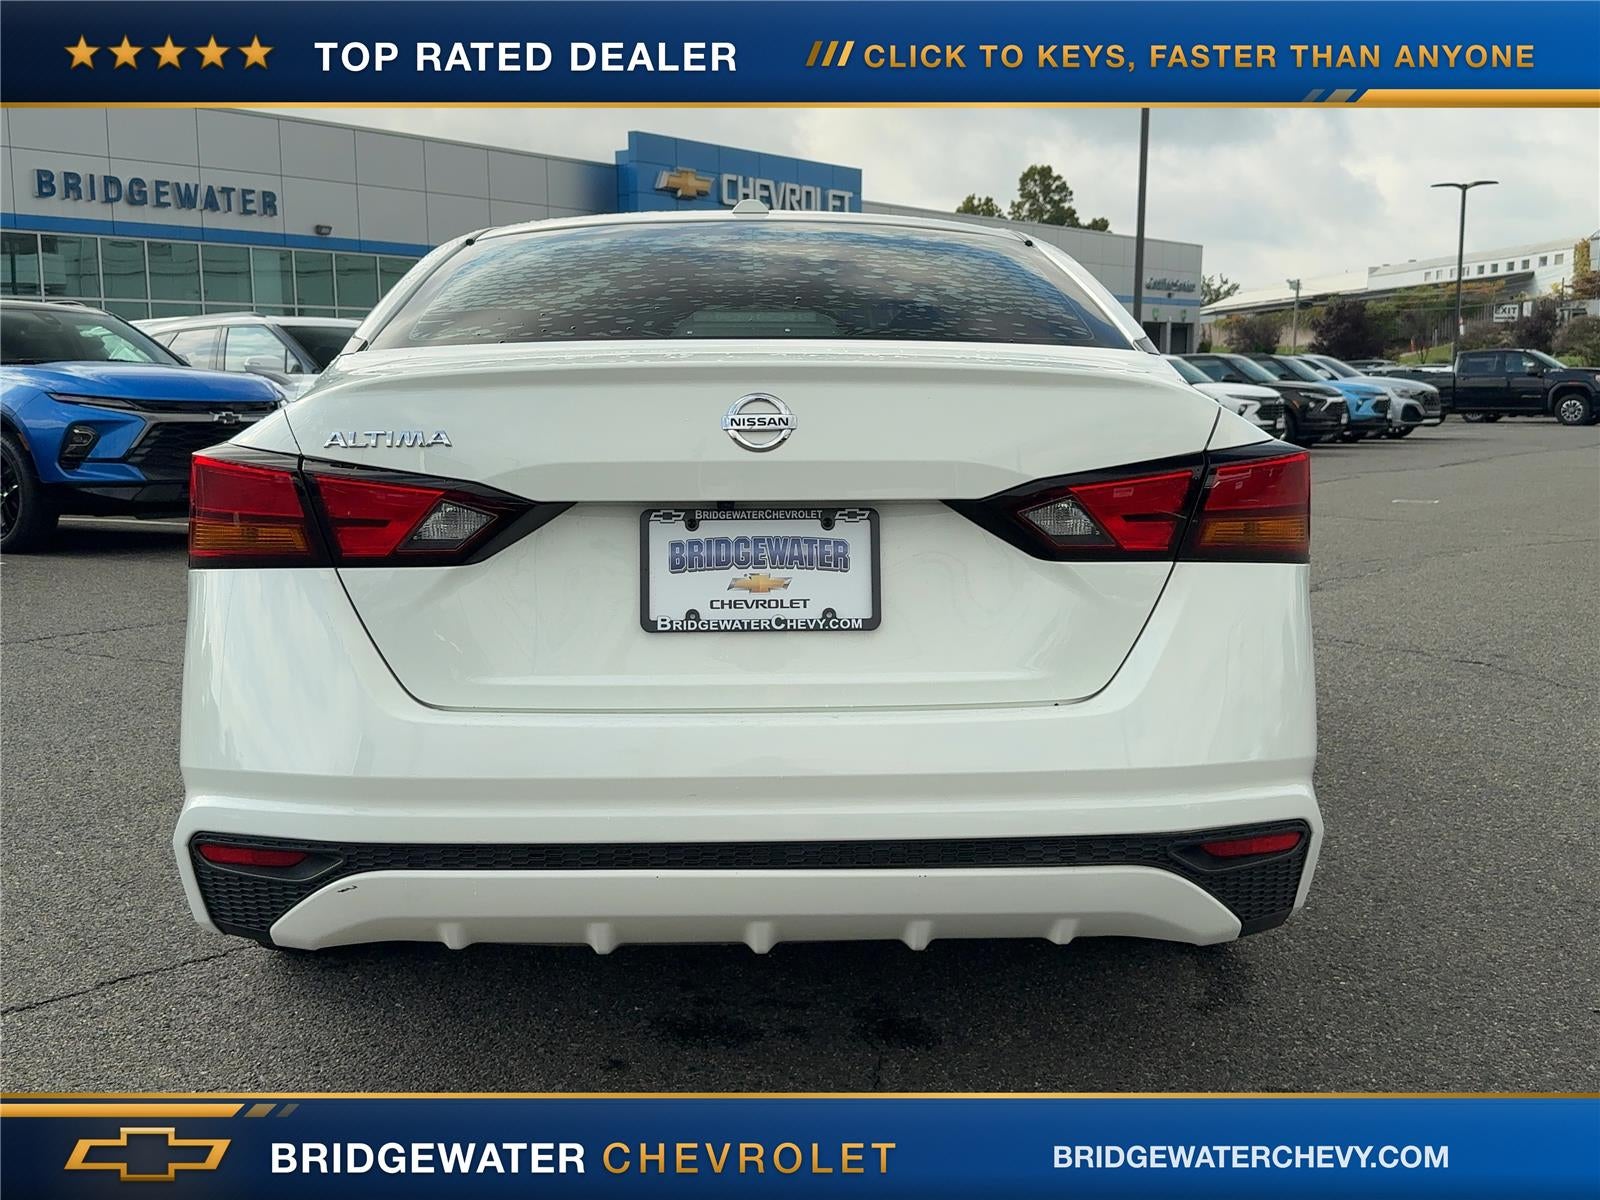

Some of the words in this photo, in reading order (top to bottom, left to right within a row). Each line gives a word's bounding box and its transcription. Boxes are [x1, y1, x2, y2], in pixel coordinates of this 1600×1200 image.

[34, 168, 278, 217] BRIDGEWATER
[720, 173, 854, 212] CHEVROLET
[1494, 306, 1517, 315] EXIT
[730, 417, 789, 427] NISSAN
[323, 429, 452, 448] ALTIMA
[668, 536, 850, 574] BRIDGEWATER
[709, 598, 811, 609] CHEVROLET
